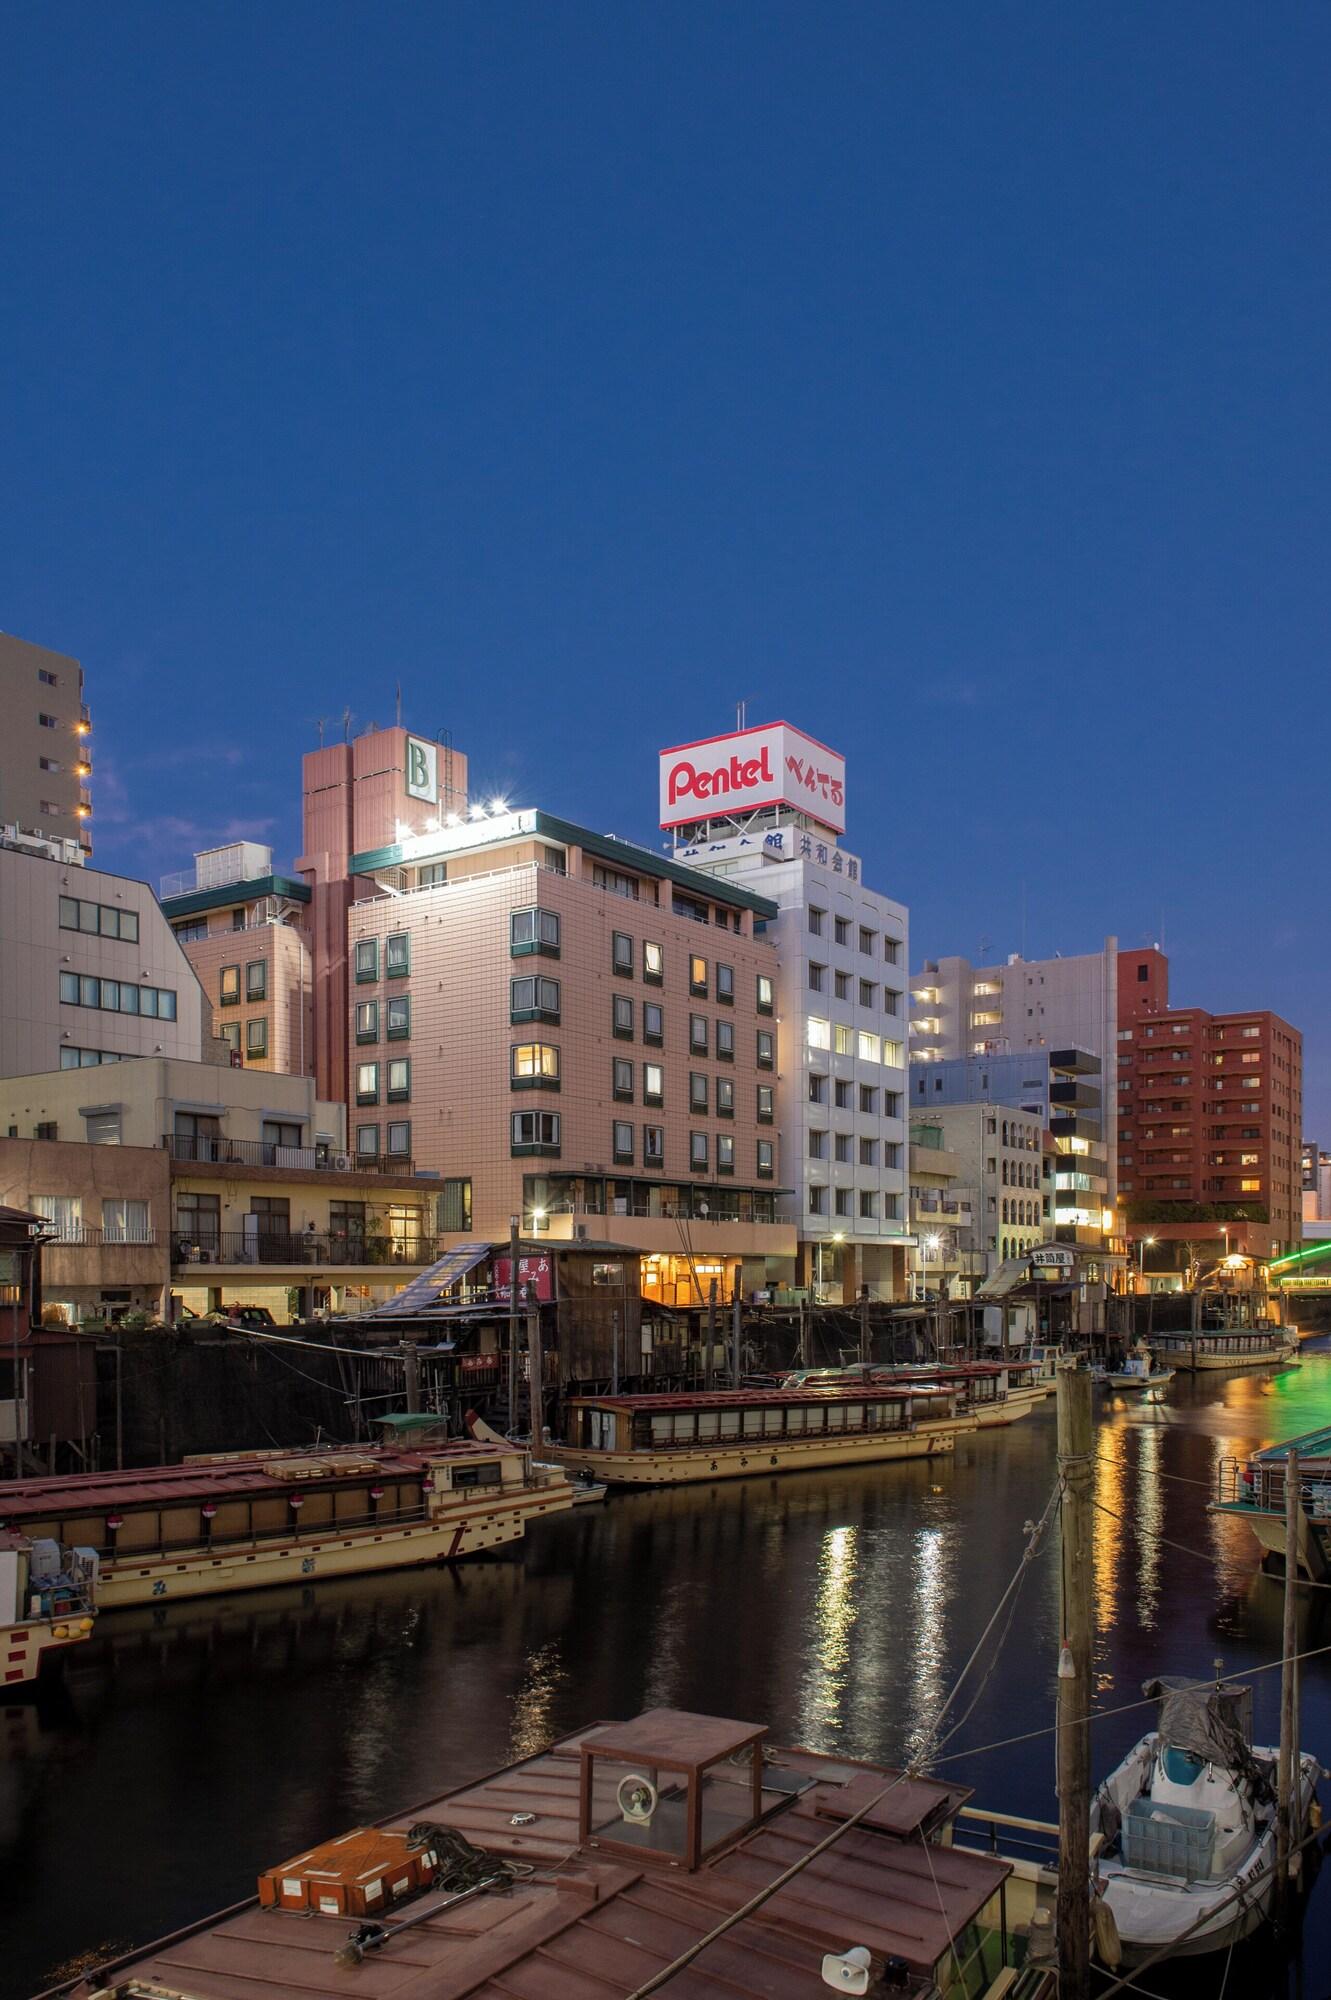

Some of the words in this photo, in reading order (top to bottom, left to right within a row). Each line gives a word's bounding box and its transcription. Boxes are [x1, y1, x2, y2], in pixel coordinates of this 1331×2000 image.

[409, 743, 429, 787] B
[668, 746, 773, 805] Pentel
[785, 756, 843, 806] ぺんてる
[800, 835, 858, 881] 共和会館
[1035, 1253, 1066, 1264] 井筒屋
